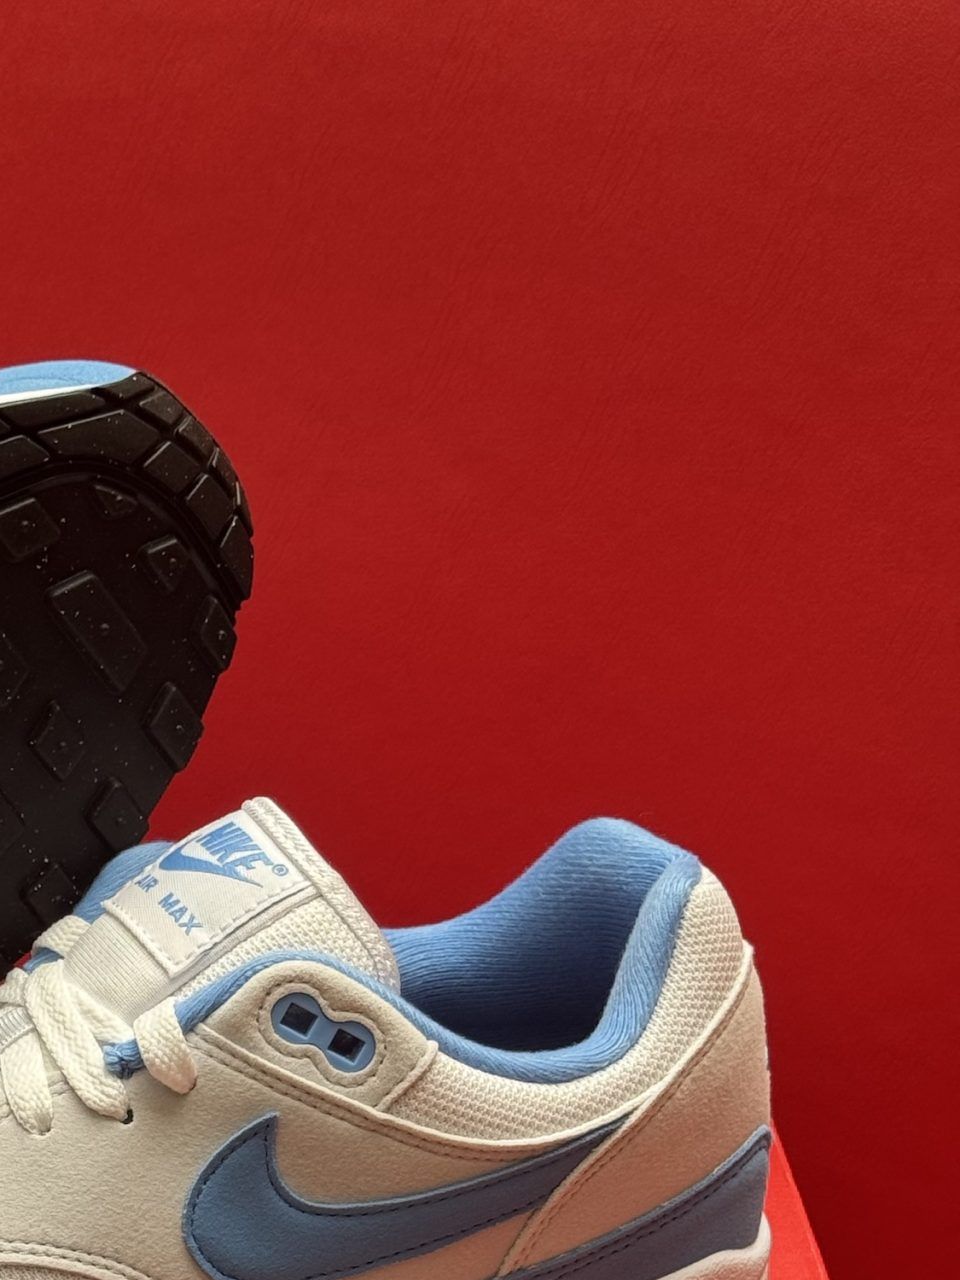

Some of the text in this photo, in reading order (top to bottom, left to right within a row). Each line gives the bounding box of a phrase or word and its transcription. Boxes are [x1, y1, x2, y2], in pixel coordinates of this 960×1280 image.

[196, 821, 274, 869] NIKE
[135, 874, 203, 936] AIR MAX
